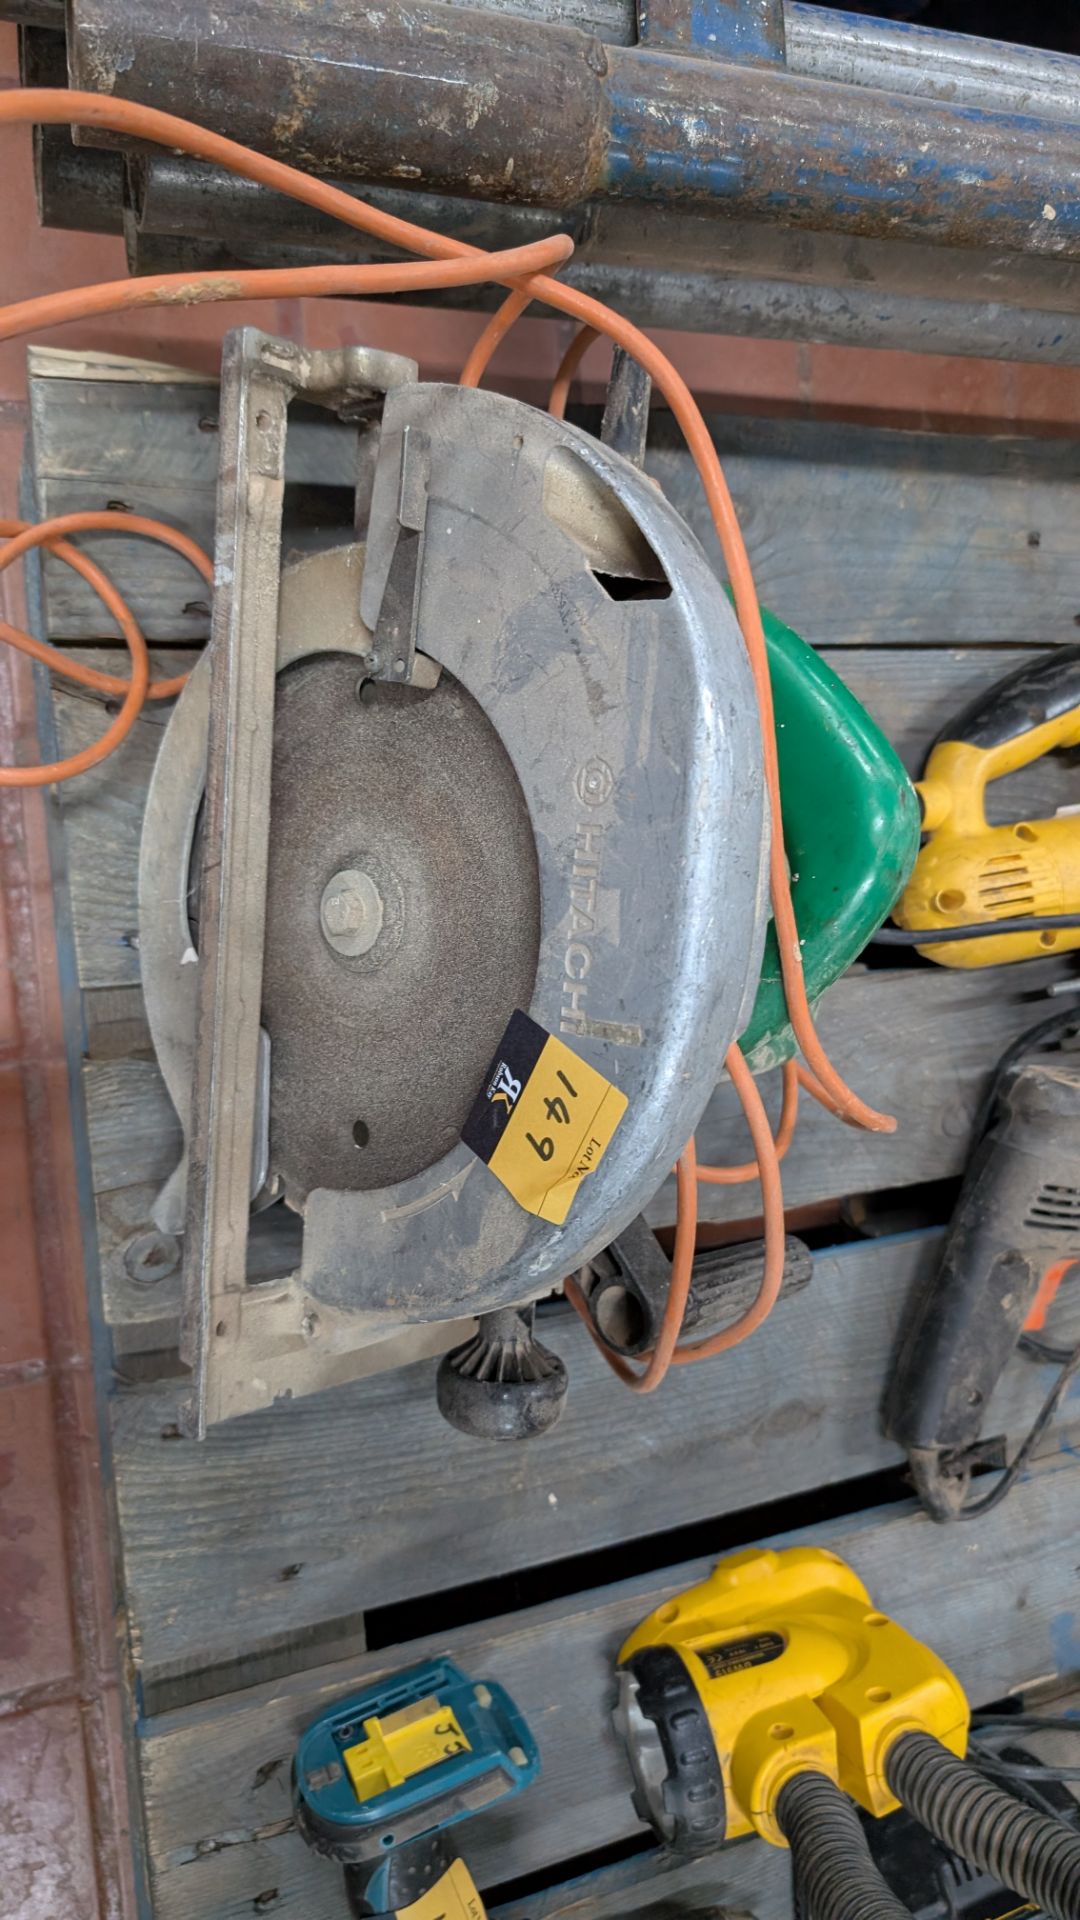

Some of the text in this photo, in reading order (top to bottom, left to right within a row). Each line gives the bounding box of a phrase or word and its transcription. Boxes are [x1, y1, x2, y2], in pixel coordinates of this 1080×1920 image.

[560, 823, 603, 1036] HITACHI
[525, 1069, 578, 1162] 149
[584, 1136, 602, 1161] Lot
